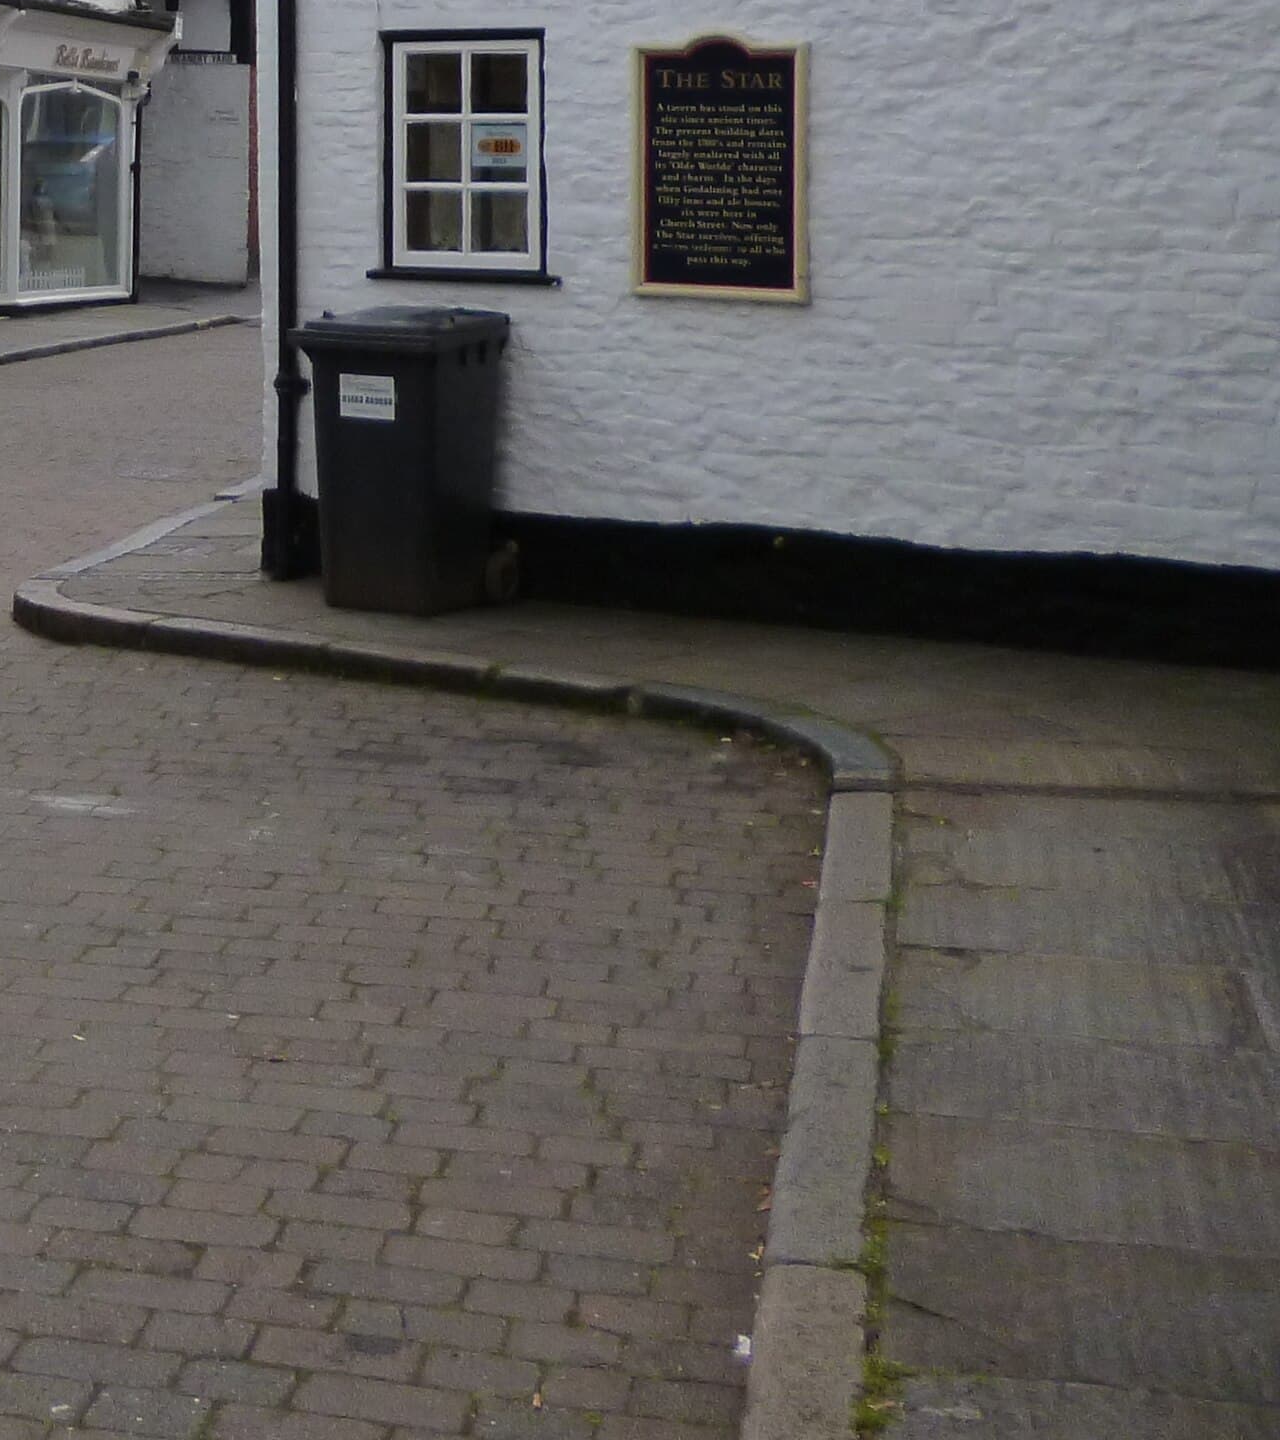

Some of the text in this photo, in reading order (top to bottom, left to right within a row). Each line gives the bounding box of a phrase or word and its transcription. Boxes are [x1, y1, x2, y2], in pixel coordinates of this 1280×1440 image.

[656, 103, 664, 112] A
[666, 104, 697, 112] tavern
[700, 104, 716, 112] has
[763, 104, 783, 113] this
[714, 127, 756, 138] building
[726, 139, 744, 147] and
[742, 151, 765, 160] with
[767, 152, 780, 160] all
[662, 173, 679, 181] and
[660, 219, 695, 228] Church
[709, 256, 728, 264] this
